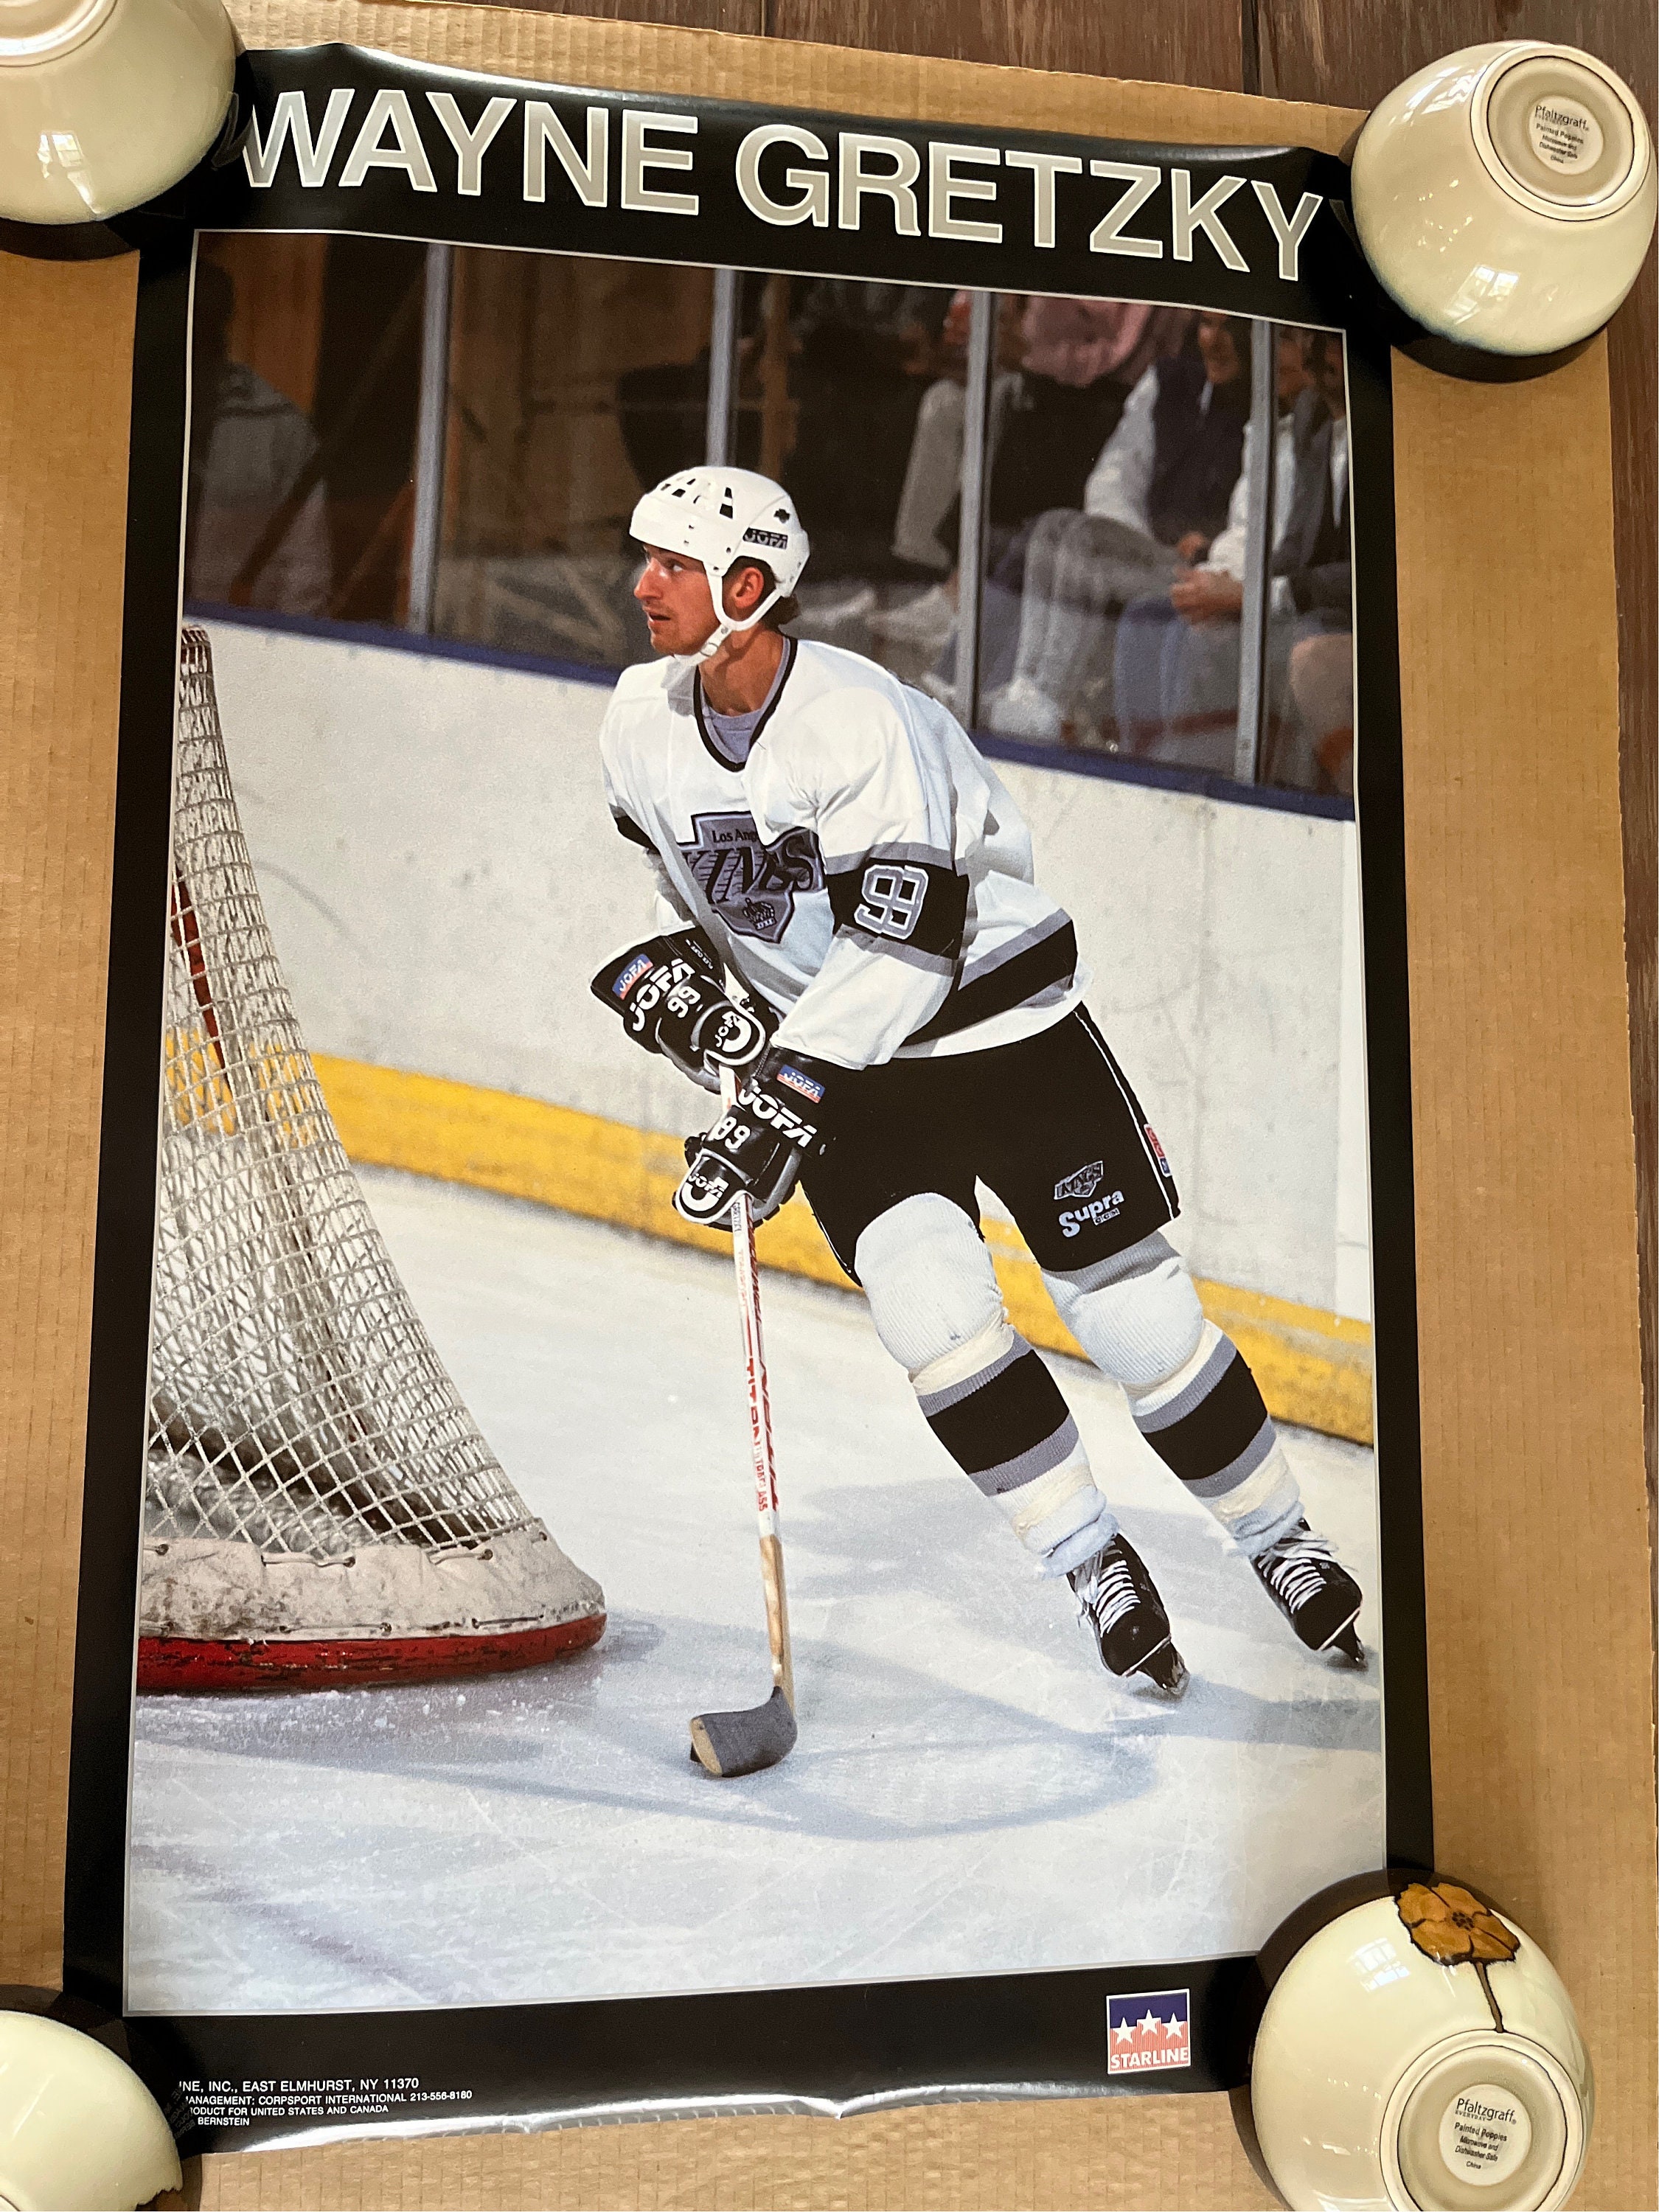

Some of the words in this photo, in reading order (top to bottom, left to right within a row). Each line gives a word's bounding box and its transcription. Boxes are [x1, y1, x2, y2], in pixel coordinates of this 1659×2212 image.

[243, 88, 700, 216] WAYNE
[735, 123, 1323, 282] GRETZKY
[712, 829, 734, 844] Los
[619, 959, 648, 992] JOFA
[629, 958, 695, 1032] JOFA
[667, 985, 701, 1018] 99
[784, 1071, 821, 1097] JOFA
[737, 1085, 818, 1148] JOFA
[1059, 1190, 1125, 1238] Supra
[1110, 2047, 1189, 2069] STARLINE
[209, 2080, 237, 2093] INC.,
[243, 2080, 276, 2093] EAST
[280, 2079, 355, 2093] ELMHURST,
[360, 2079, 379, 2090] NY
[383, 2077, 420, 2090] 11370
[258, 2095, 322, 2106] CORPSPORT
[325, 2093, 407, 2104] INTERNATIONAL
[410, 2090, 473, 2101] 213-556-8180
[198, 2116, 250, 2126] BERNSTEIN
[228, 2107, 248, 2115] FOR
[250, 2107, 285, 2116] UNITED
[288, 2107, 324, 2115] STATES
[326, 2106, 347, 2115] AND
[349, 2104, 389, 2114] CANADA
[1455, 2122, 1481, 2135] Painted
[1481, 2129, 1507, 2142] Poppies
[1466, 2160, 1481, 2169] China
